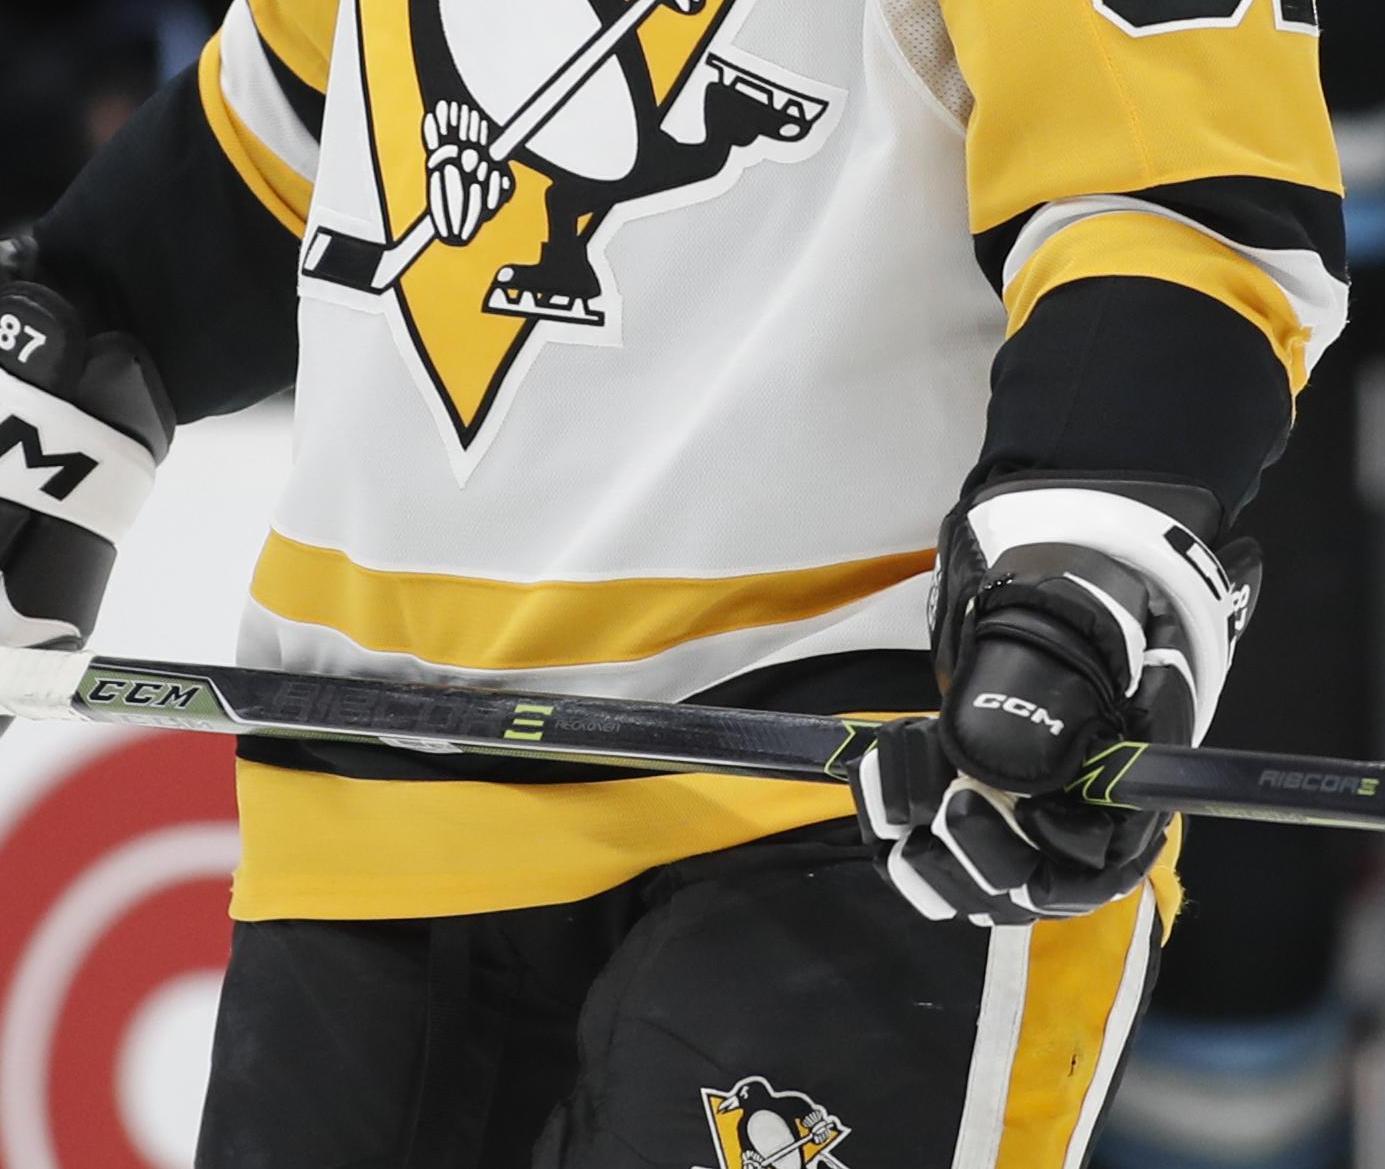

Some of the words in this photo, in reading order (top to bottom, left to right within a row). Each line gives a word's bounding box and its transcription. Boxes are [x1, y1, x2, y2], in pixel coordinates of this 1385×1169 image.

[88, 677, 204, 709] CCM
[972, 693, 1065, 736] CCM
[1258, 769, 1381, 796] RIBCORE
